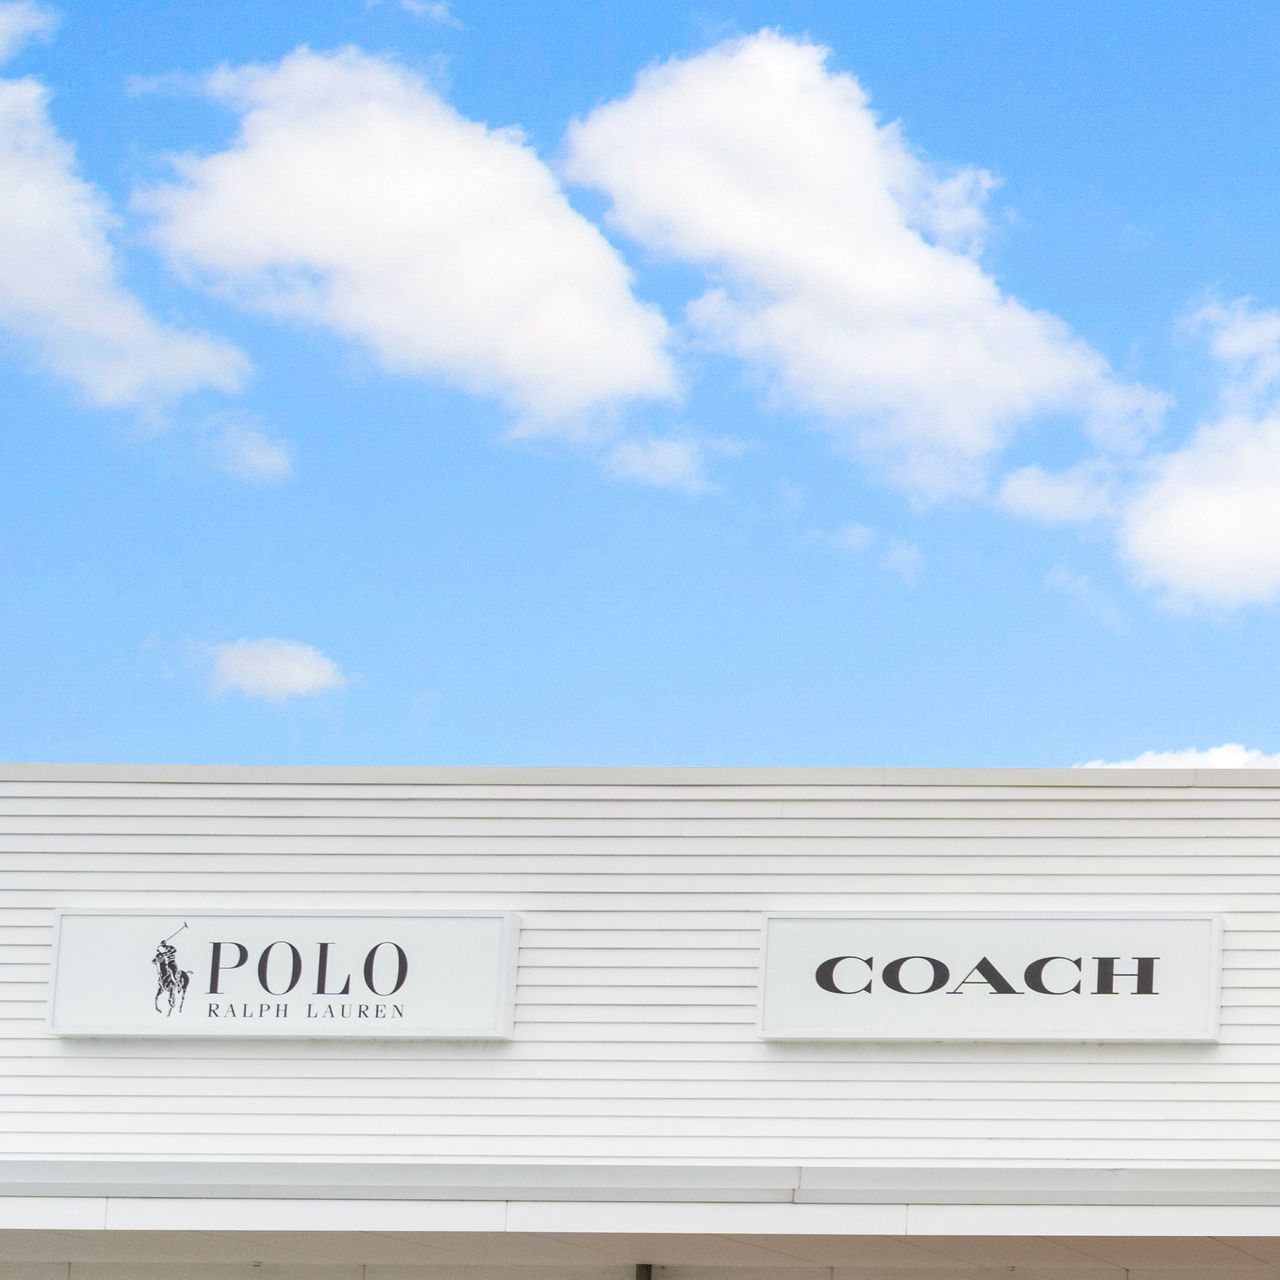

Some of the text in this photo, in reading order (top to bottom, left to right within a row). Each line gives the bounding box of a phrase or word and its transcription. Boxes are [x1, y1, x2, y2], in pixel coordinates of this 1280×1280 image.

[205, 941, 409, 997] POLO
[815, 955, 1160, 995] COACH
[207, 1003, 406, 1019] RALPH LAUREN
